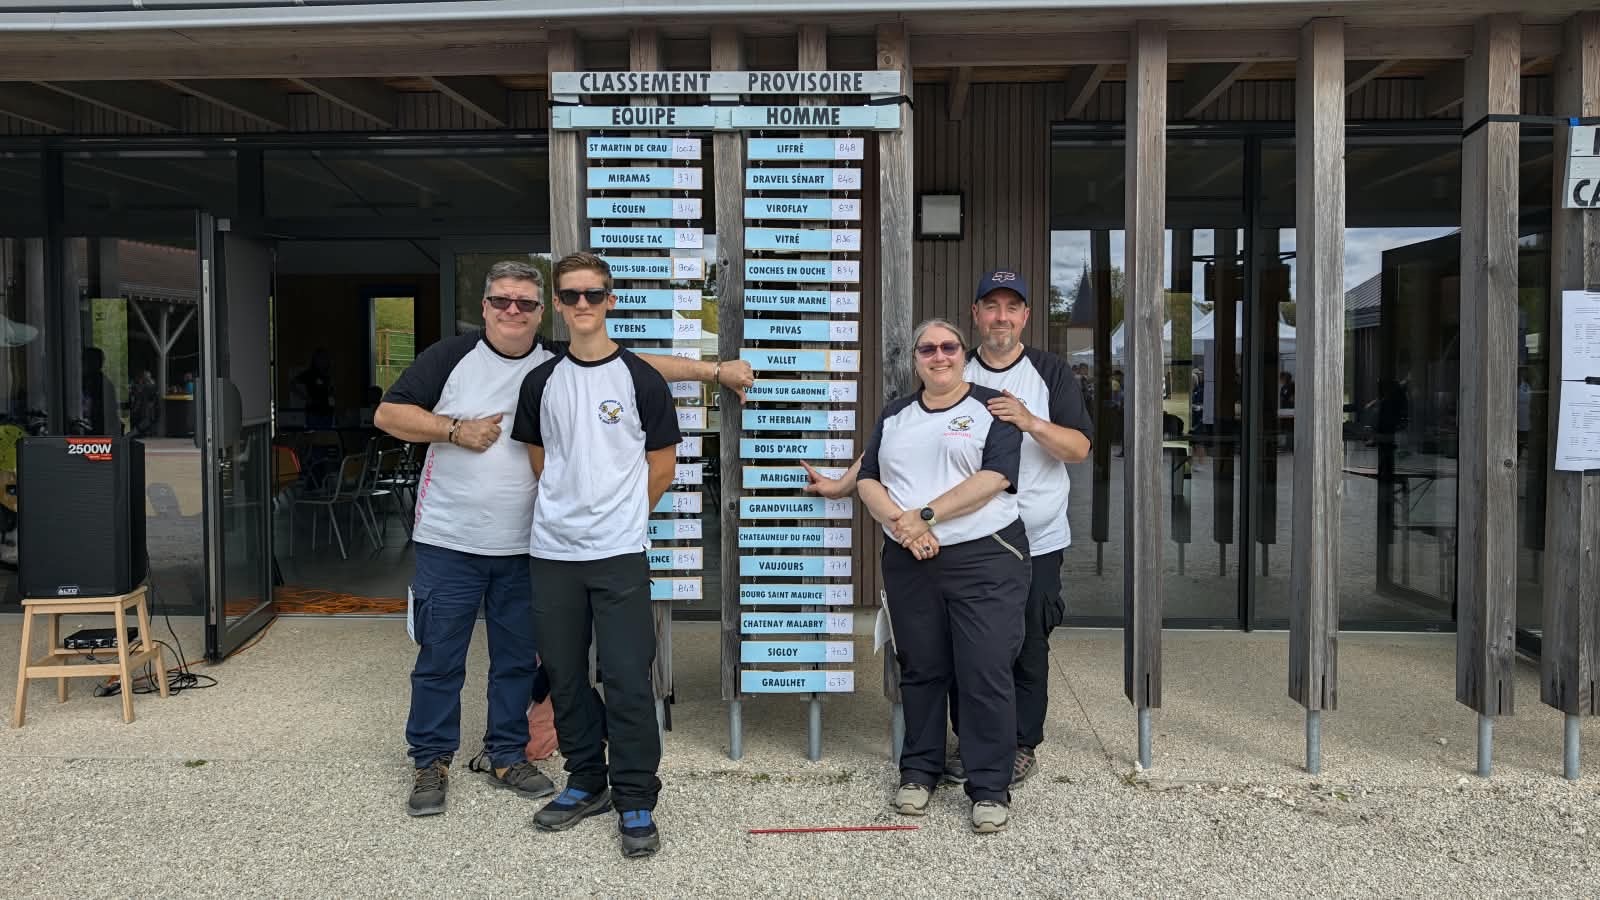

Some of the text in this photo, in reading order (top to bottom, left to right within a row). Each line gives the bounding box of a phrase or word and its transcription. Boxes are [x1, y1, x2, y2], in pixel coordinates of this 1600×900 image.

[579, 72, 863, 92] CLASSEMENT PROVISOIRE
[766, 107, 840, 125] HOMME
[589, 143, 668, 152] ST MARTIN DE CRAU
[777, 142, 804, 153] LIFFRÉ
[839, 143, 856, 153] 848
[608, 173, 651, 183] MIRAMAS
[752, 173, 825, 184] DRAVEIL SÉNART
[612, 202, 646, 214] ÉCOUEN
[766, 204, 808, 213] VIROFLAY
[601, 234, 663, 244] TOULOUSE TAC
[775, 233, 800, 244] VITRÉ
[609, 264, 669, 273] OUIS-SUR-LOIRE
[748, 266, 826, 275] CONCHES EN OUCHE
[745, 295, 827, 305] NEUILLY SUR MARNE
[613, 324, 646, 333] EYBENS
[769, 325, 802, 335] PRIVAS
[767, 355, 797, 365] VALLET
[744, 387, 826, 396] VERDUN SUR GARONNE
[757, 415, 811, 424] ST HERBLAIN
[68, 444, 112, 455] 2500W
[754, 444, 808, 453] BOIS D'ARCY
[749, 503, 814, 513] GRANDVILLARS
[739, 533, 789, 541] CHATEAUNEUF
[802, 534, 821, 542] FAOU
[759, 561, 804, 571] VAUJOURS
[741, 590, 823, 599] BOURG SAINT MAURICE
[743, 619, 824, 628] CHATENAY MALABRY
[767, 647, 799, 657] SIGLOY
[762, 678, 806, 687] GRAULHET
